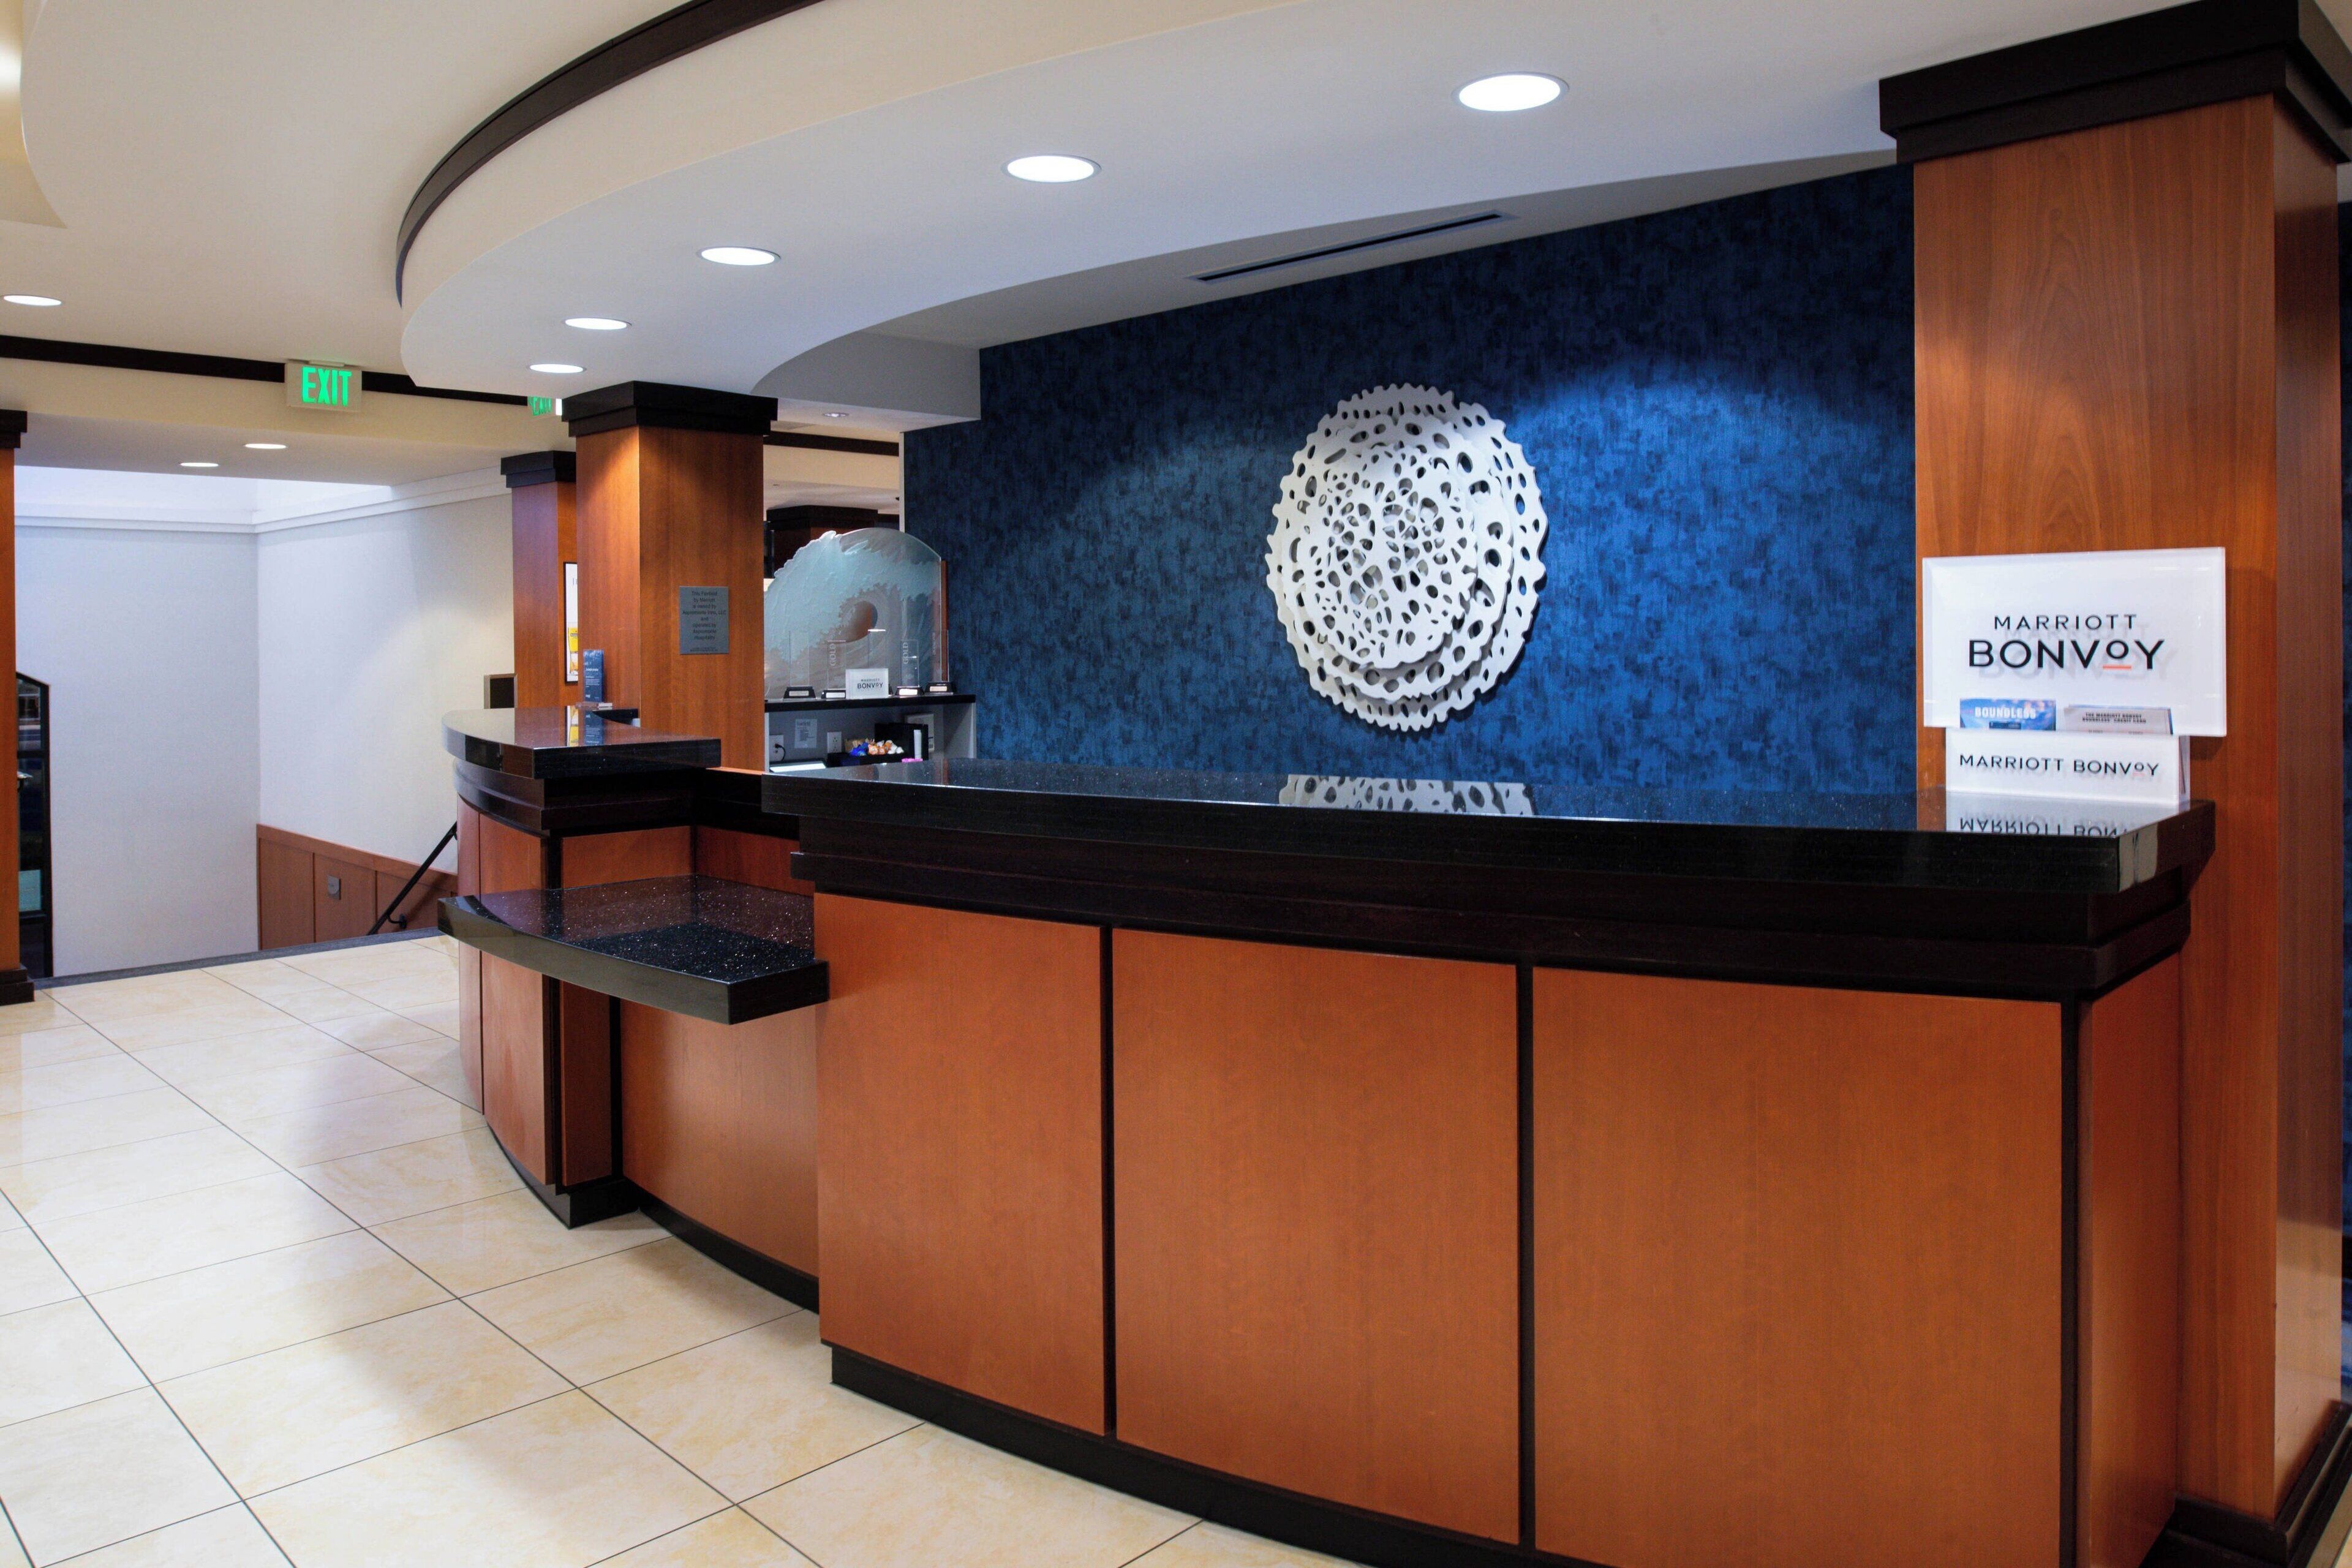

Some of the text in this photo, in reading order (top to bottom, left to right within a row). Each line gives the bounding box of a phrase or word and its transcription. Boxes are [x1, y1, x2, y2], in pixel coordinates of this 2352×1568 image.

[301, 366, 352, 407] EXIT
[1994, 614, 2137, 630] MARRIOTT
[1969, 639, 2165, 669] BONVOY
[1974, 706, 2037, 720] BOUNDLESS
[1959, 754, 2160, 776] MARRIOTT BONVOY
